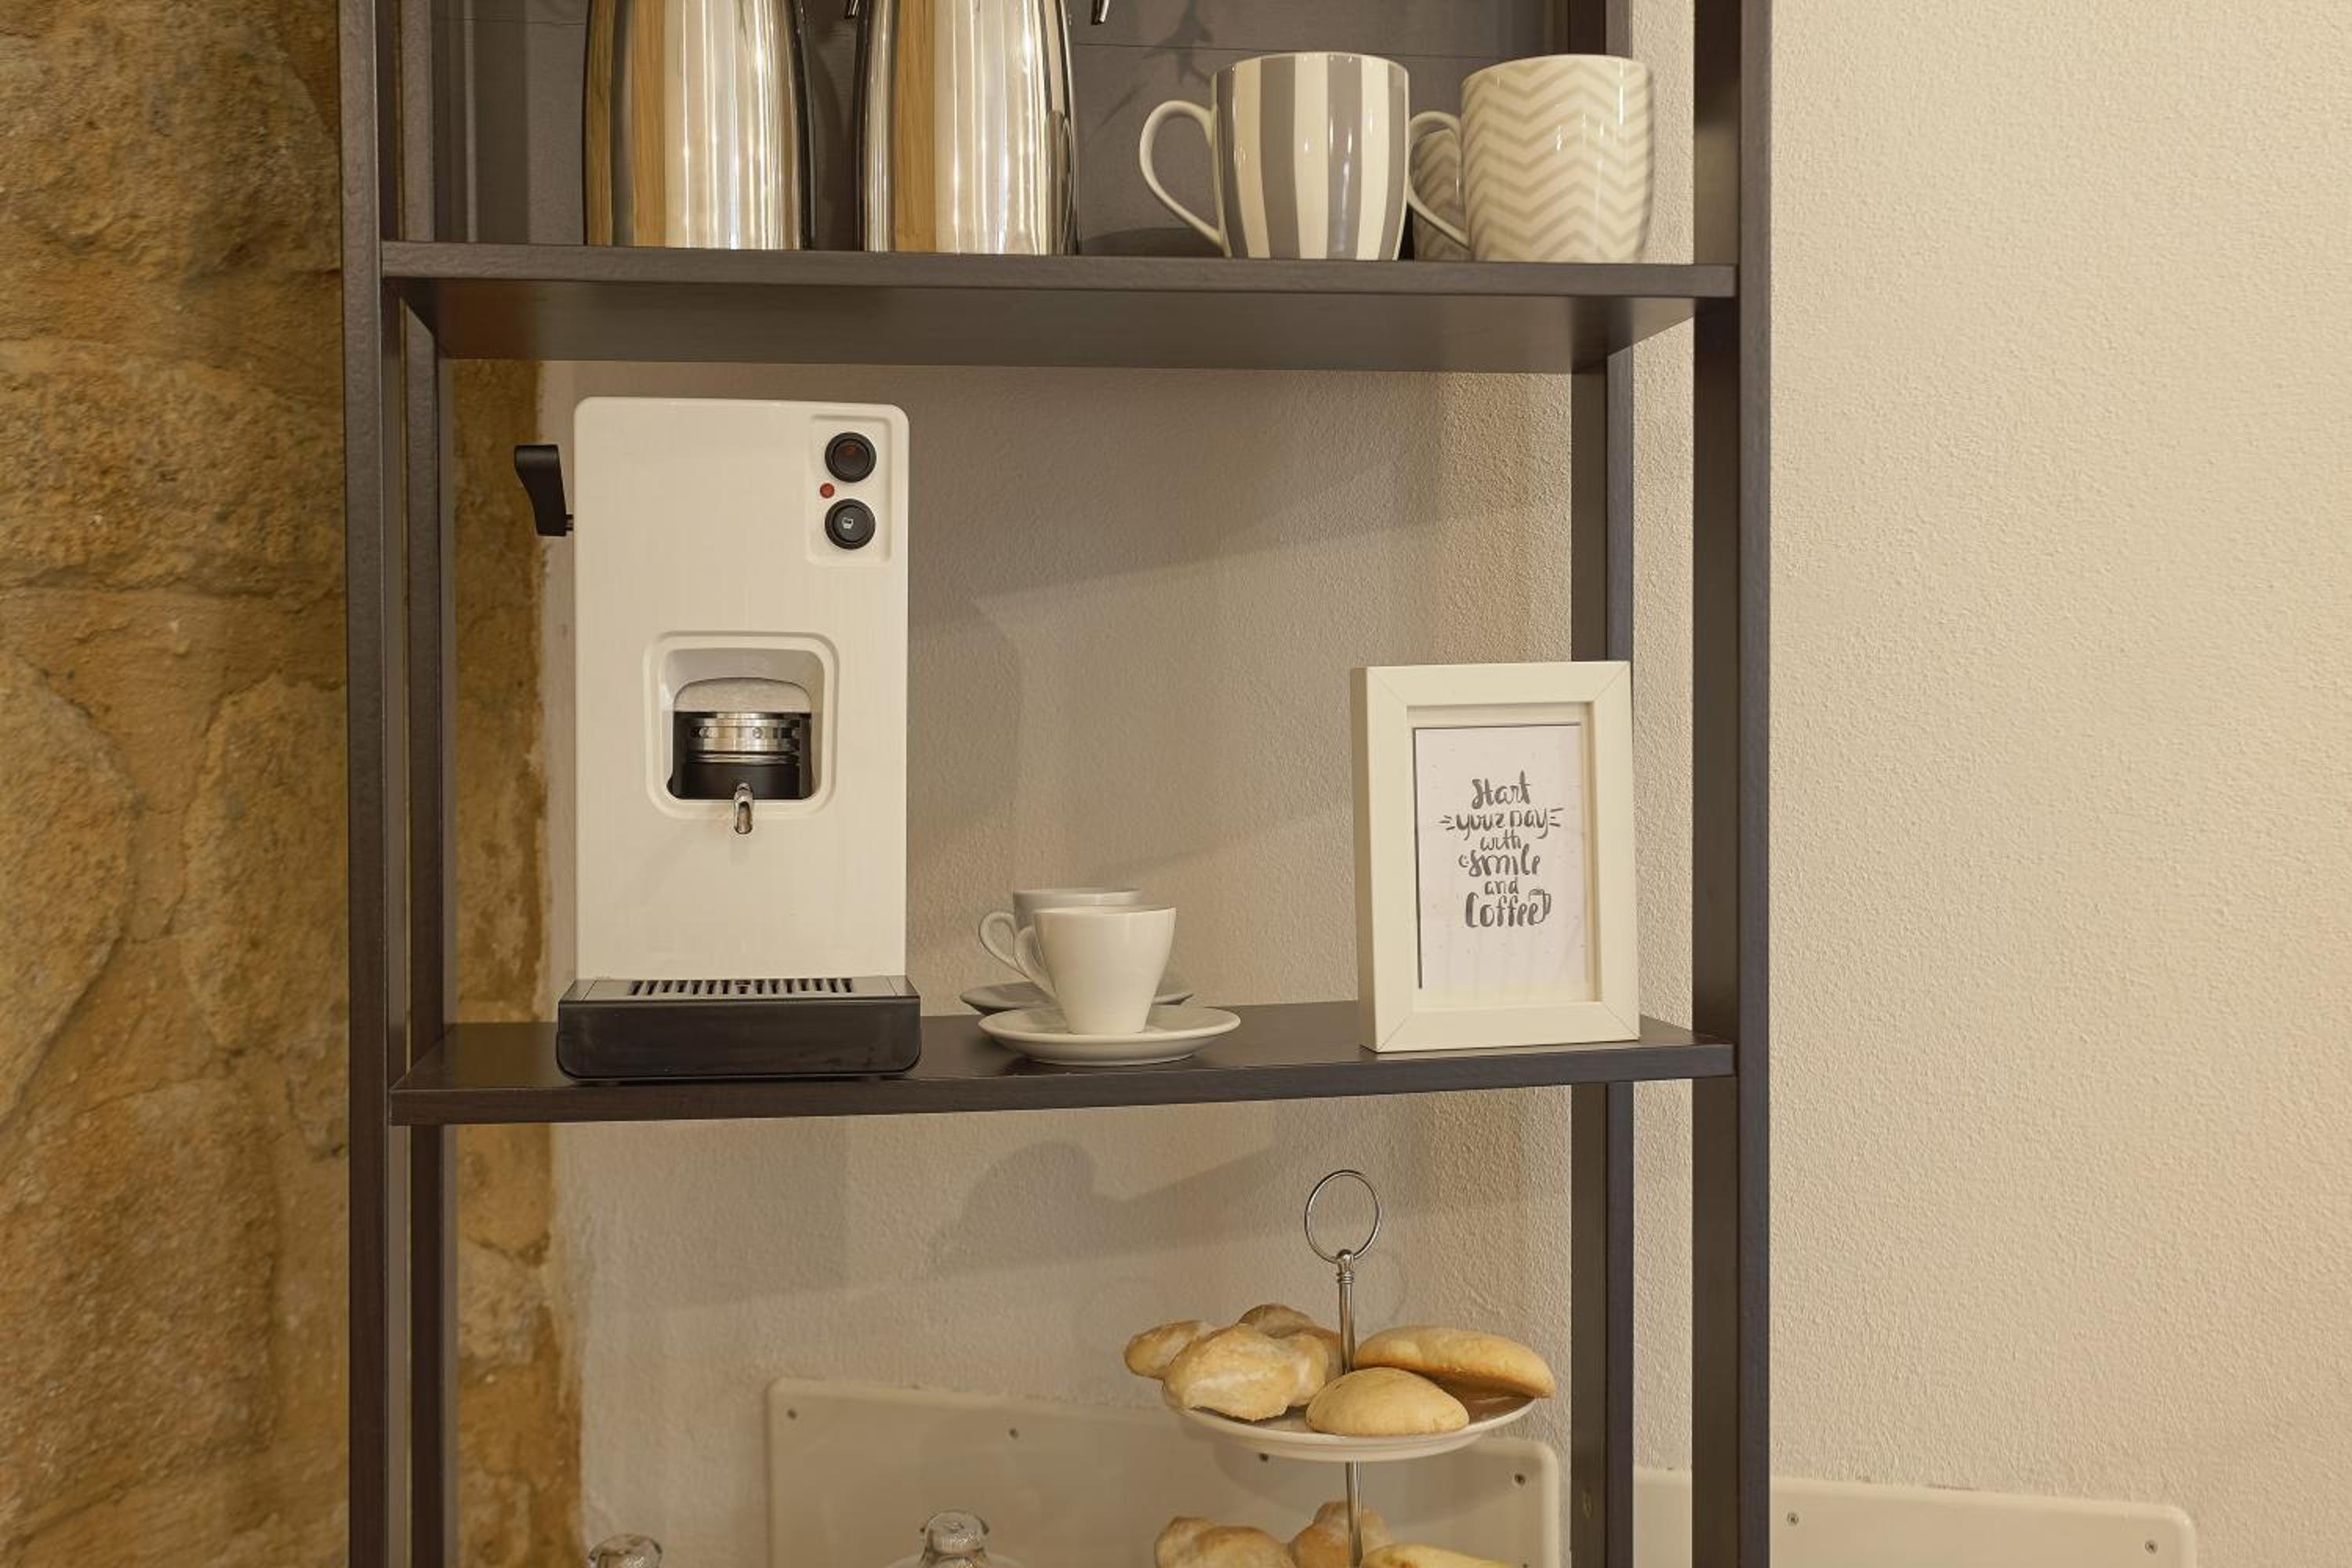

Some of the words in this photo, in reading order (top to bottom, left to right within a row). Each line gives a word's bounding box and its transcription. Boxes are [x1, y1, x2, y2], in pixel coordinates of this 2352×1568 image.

[1471, 770, 1530, 809] Start
[1479, 829, 1522, 851] with
[1484, 877, 1519, 895] and
[1465, 891, 1539, 927] Coffee
